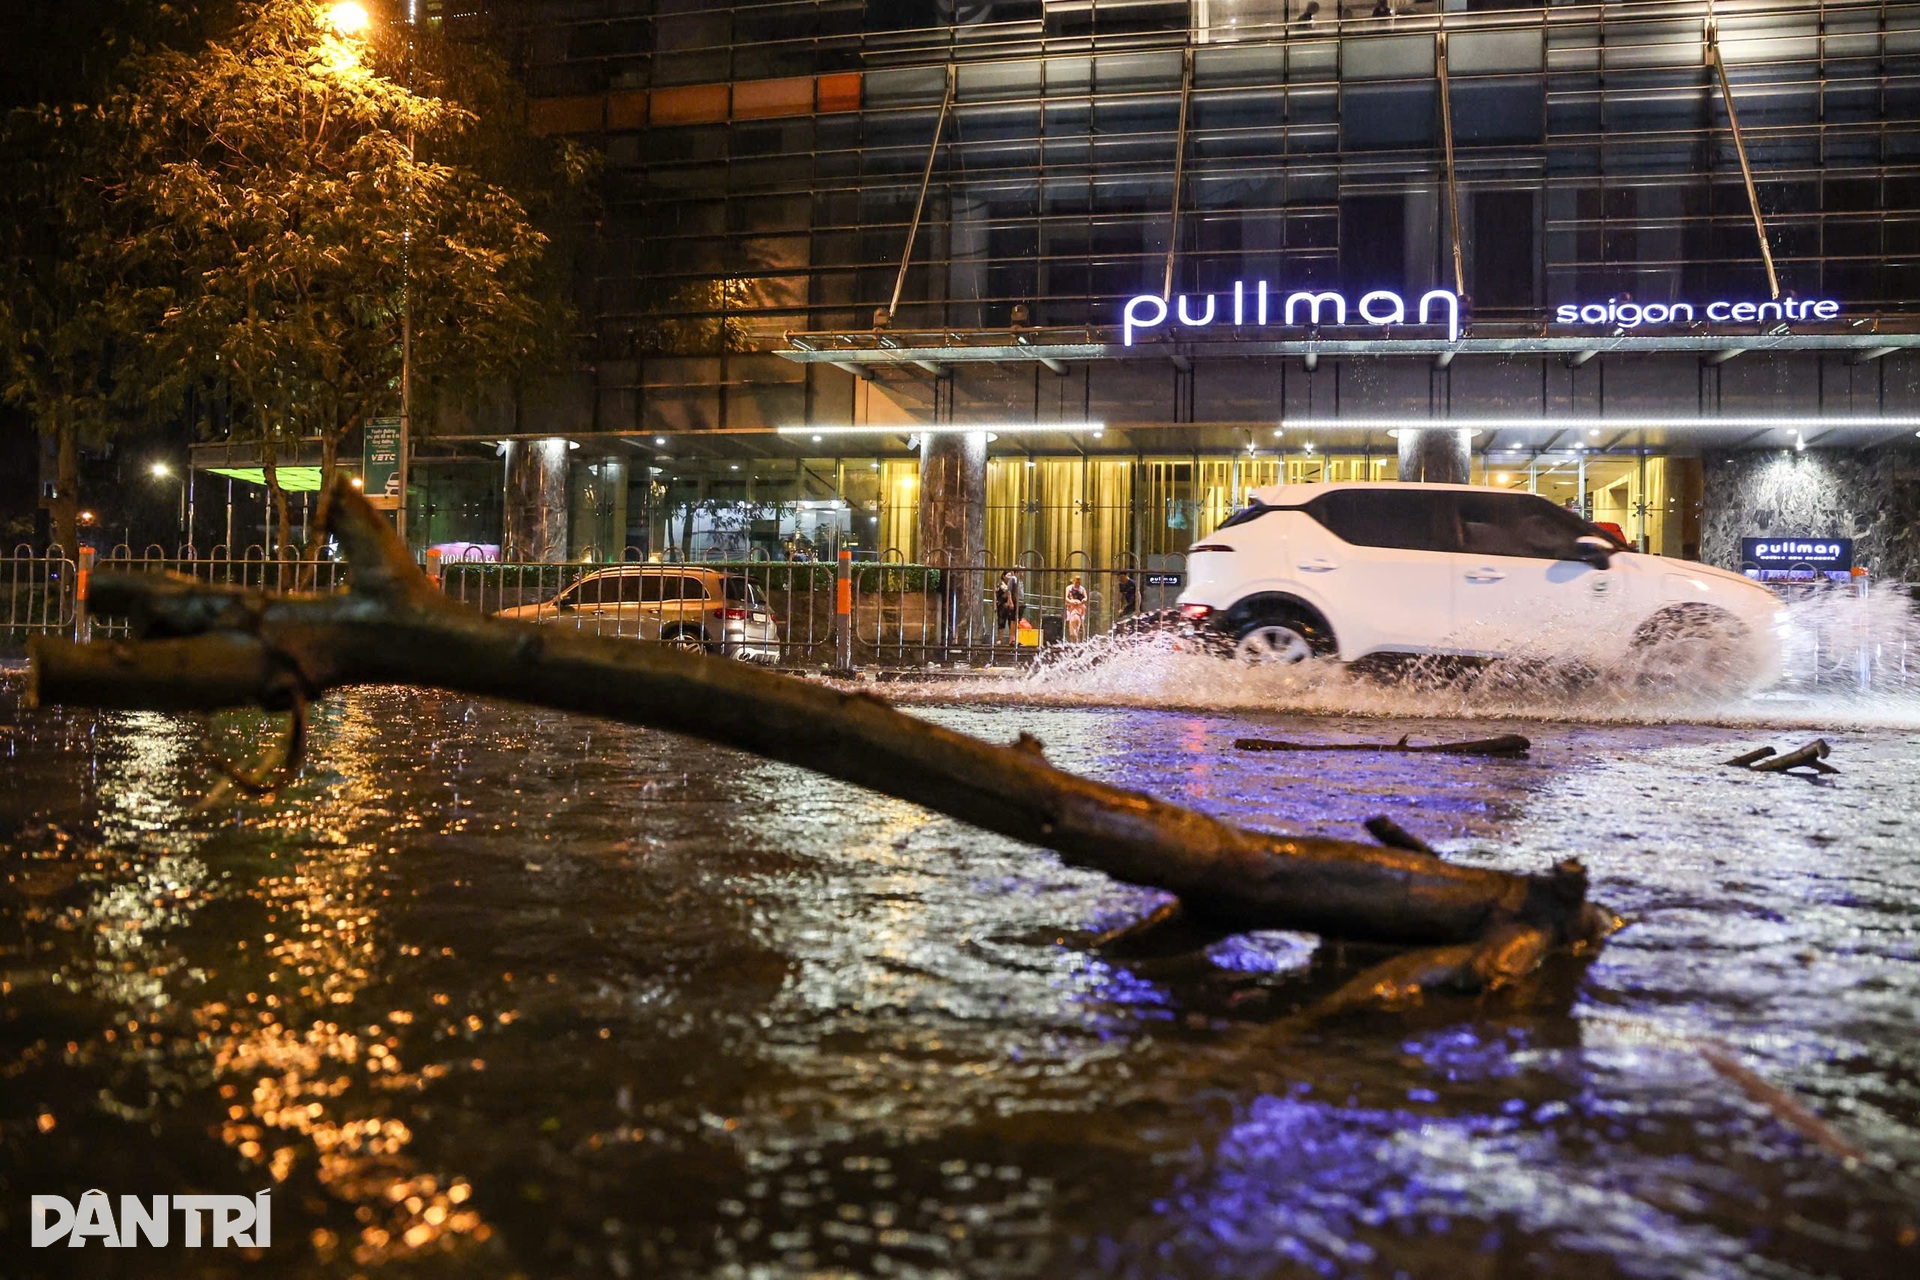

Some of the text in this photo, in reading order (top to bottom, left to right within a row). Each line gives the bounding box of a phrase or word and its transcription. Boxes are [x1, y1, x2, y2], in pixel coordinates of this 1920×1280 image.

[1124, 280, 1458, 347] pullman
[1556, 297, 1840, 328] saigon centre
[371, 453, 396, 462] VETC
[1755, 541, 1841, 557] pullman
